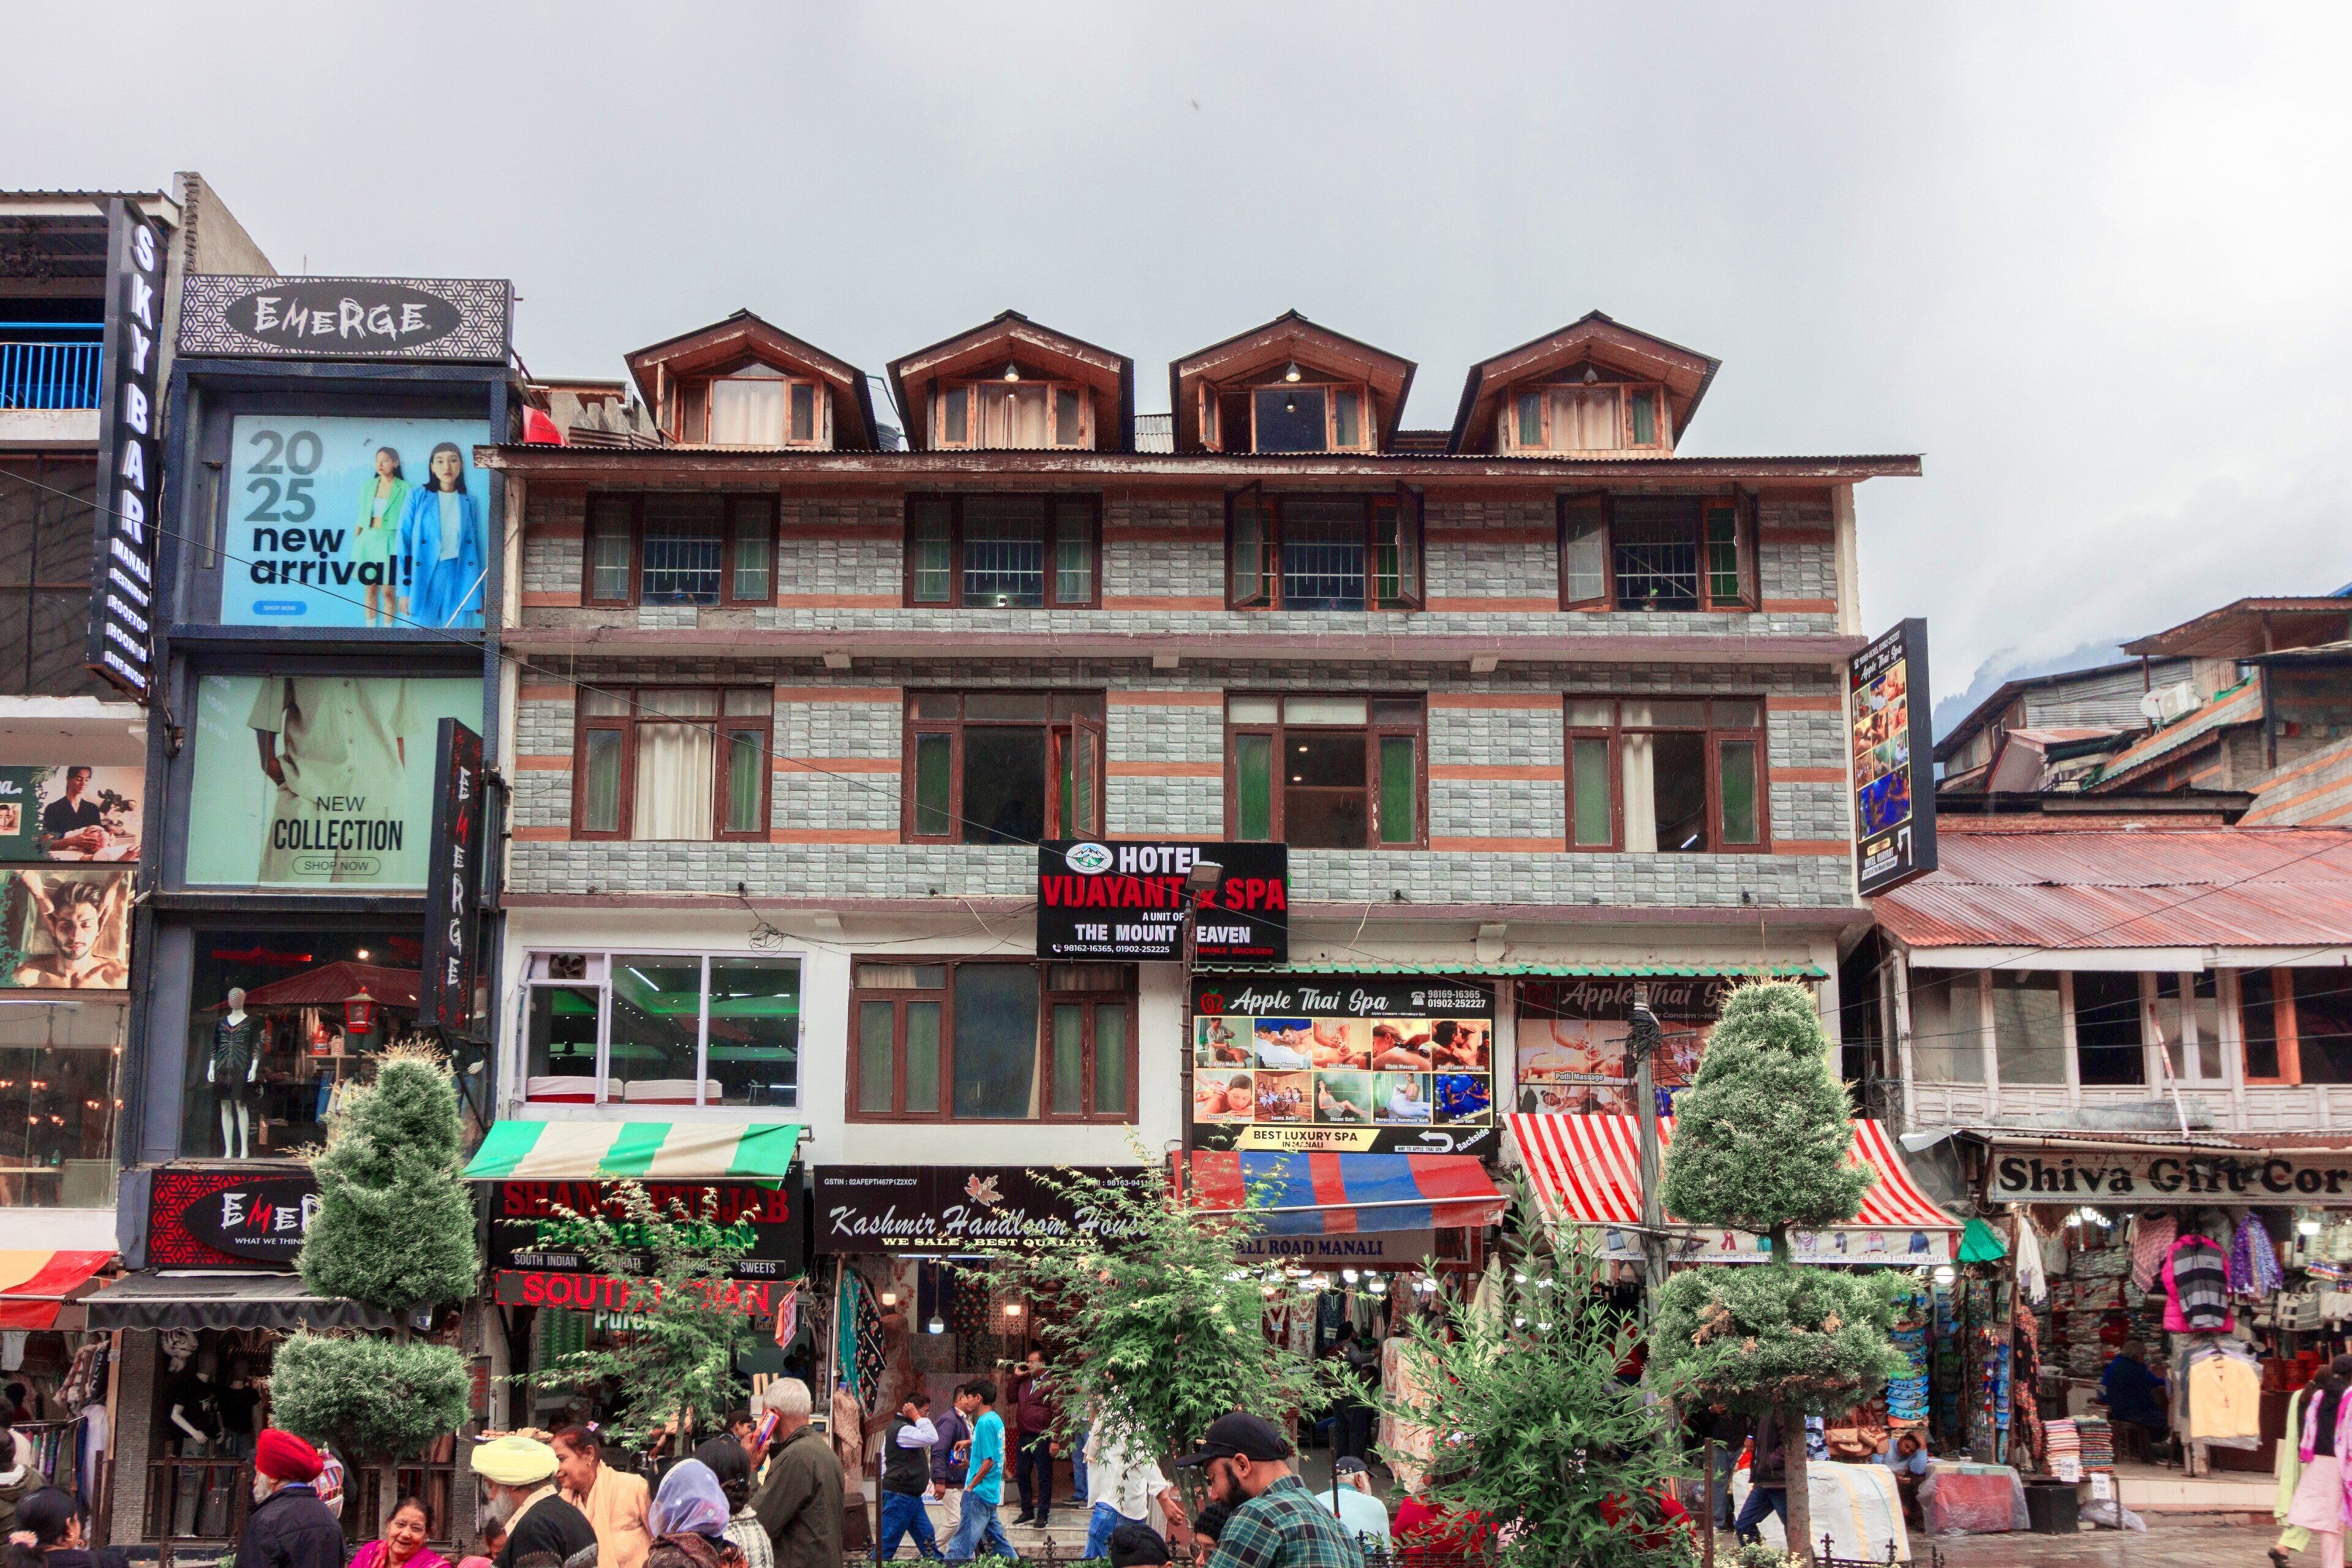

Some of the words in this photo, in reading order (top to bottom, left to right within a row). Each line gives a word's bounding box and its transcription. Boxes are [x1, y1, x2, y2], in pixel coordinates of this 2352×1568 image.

[254, 296, 428, 341] EMERGE
[247, 430, 323, 475] 20
[244, 477, 316, 523] 25
[253, 527, 345, 552] new
[111, 538, 151, 583] MANALI
[250, 551, 413, 586] arrival!
[107, 595, 148, 633] ROOFTOP
[106, 622, 147, 663] HOOKH
[104, 650, 124, 674] LIVE
[124, 663, 146, 688] MUSIC
[316, 796, 366, 812] NEW
[274, 818, 404, 851] COLLECTION
[304, 861, 336, 870] SHOP
[340, 861, 370, 871] NOW
[448, 766, 471, 988] EMERGE
[1042, 875, 1185, 908] VIJAYANT
[1225, 878, 1286, 910] SPA
[1074, 924, 1108, 941] THE
[1115, 925, 1177, 942] MOUNT
[1196, 926, 1251, 943] EAVEN
[1063, 944, 1114, 954] 98162-16365,
[1232, 947, 1275, 956] BACKSIDE
[1229, 987, 1291, 1015] Apple
[1298, 987, 1341, 1011] Thai
[1349, 989, 1389, 1016] Spa
[1428, 990, 1480, 998] 98169-16365
[1428, 999, 1487, 1008] 01902-252227
[1561, 982, 1635, 1011] Apple
[1573, 1073, 1604, 1082] Massage
[1253, 1131, 1281, 1139] BEST
[1285, 1131, 1331, 1141] LUXURY
[1334, 1132, 1358, 1141] SPA
[1455, 1128, 1490, 1152] Backside
[1999, 1157, 2135, 1193] Shiva
[2148, 1156, 2247, 1193] Gift
[2260, 1158, 2352, 1193] Cor
[221, 1193, 321, 1234] EMER
[829, 1205, 937, 1237] Kashmir
[943, 1205, 1067, 1236] Handloom
[1022, 1238, 1098, 1247] QUALITY
[1230, 1240, 1265, 1254] ALL
[1268, 1240, 1314, 1254] ROAD
[1318, 1240, 1383, 1254] MANALI
[514, 1254, 543, 1265] SOUTH
[547, 1256, 578, 1267] INDIAN
[740, 1262, 775, 1274] SWEETS
[1915, 1255, 1945, 1264] Craft
[594, 1310, 644, 1330] Pure
